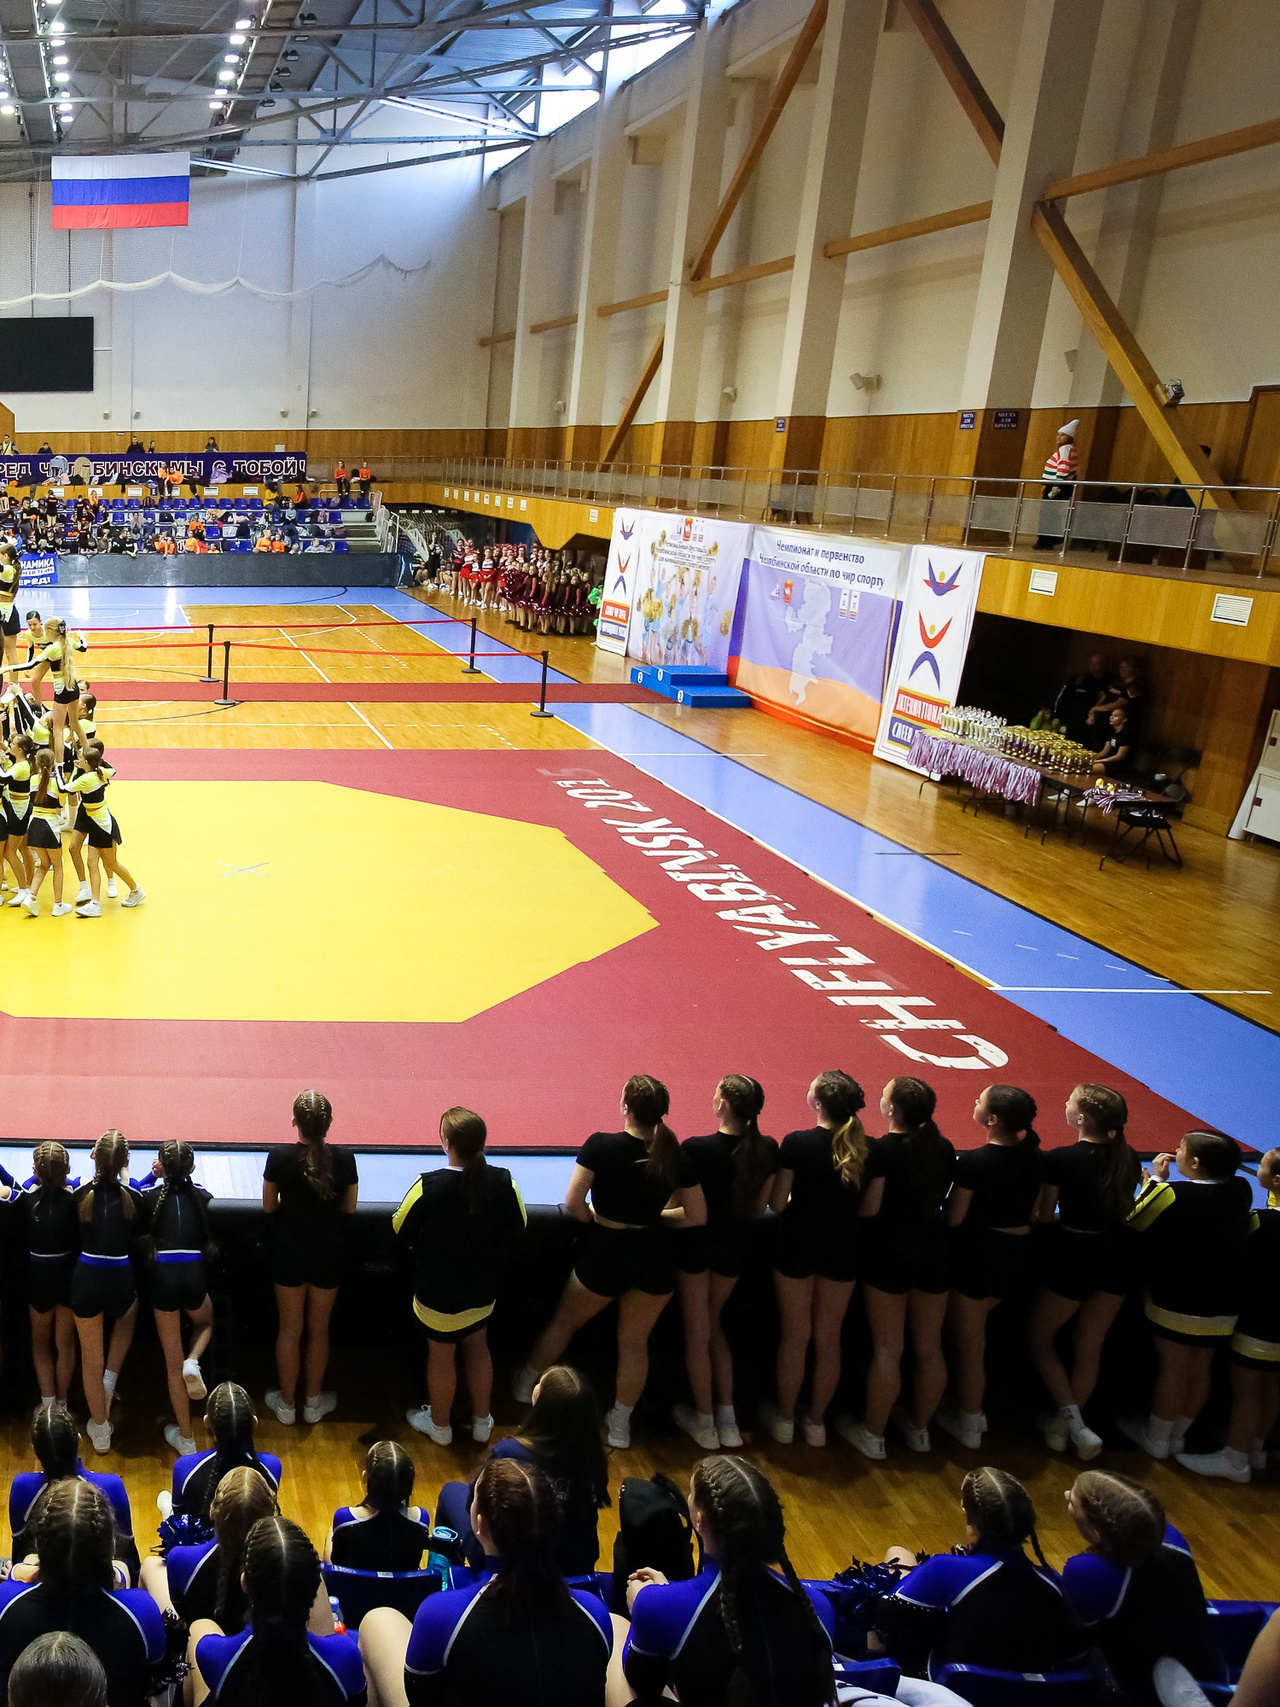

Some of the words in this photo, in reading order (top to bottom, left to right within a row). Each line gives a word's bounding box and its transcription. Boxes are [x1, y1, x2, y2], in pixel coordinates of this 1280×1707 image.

[39, 461, 162, 477] ЧЛБИНСК
[233, 456, 306, 476] ТОБОЙ!
[20, 558, 55, 569] НАМИКА
[777, 540, 815, 556] Чемпионат
[820, 549, 865, 564] первенство
[19, 576, 51, 586] ЕРЁД!
[759, 552, 800, 570] Челябинской
[800, 562, 829, 577] области
[829, 569, 841, 579] по
[842, 571, 856, 585] чир
[856, 573, 886, 591] спорту
[896, 693, 942, 725] INTERNATIONA
[891, 721, 914, 744] CHEER
